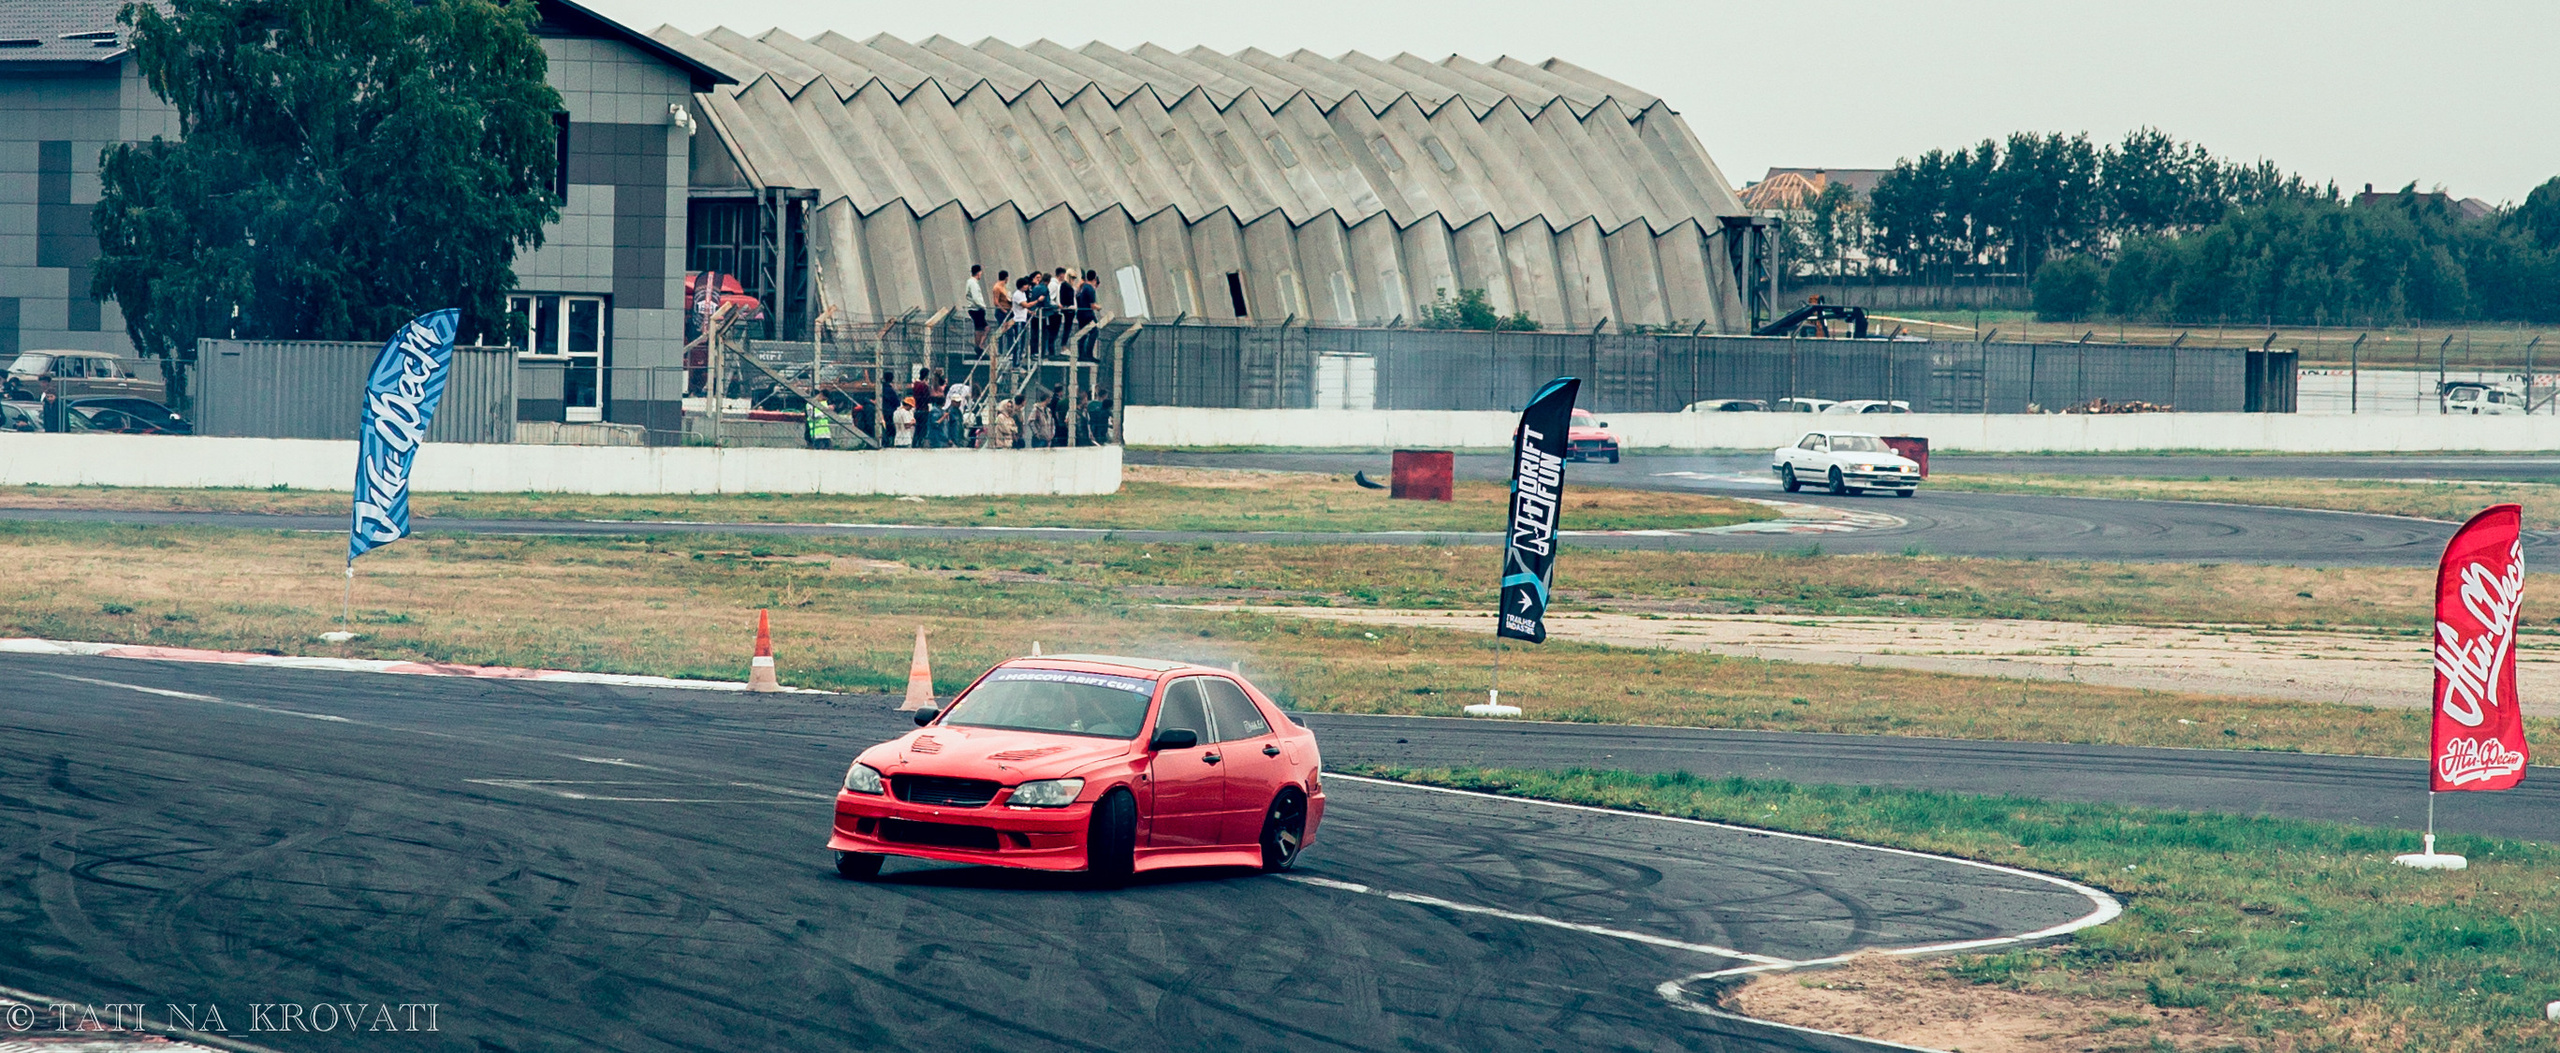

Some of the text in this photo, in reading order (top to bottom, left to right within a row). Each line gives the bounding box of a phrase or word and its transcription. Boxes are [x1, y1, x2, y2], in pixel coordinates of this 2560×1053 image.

[1518, 424, 1544, 496] DRIFT
[1537, 451, 1562, 499] FUN
[1005, 673, 1137, 691] MOSCOW DRIFT CUP
